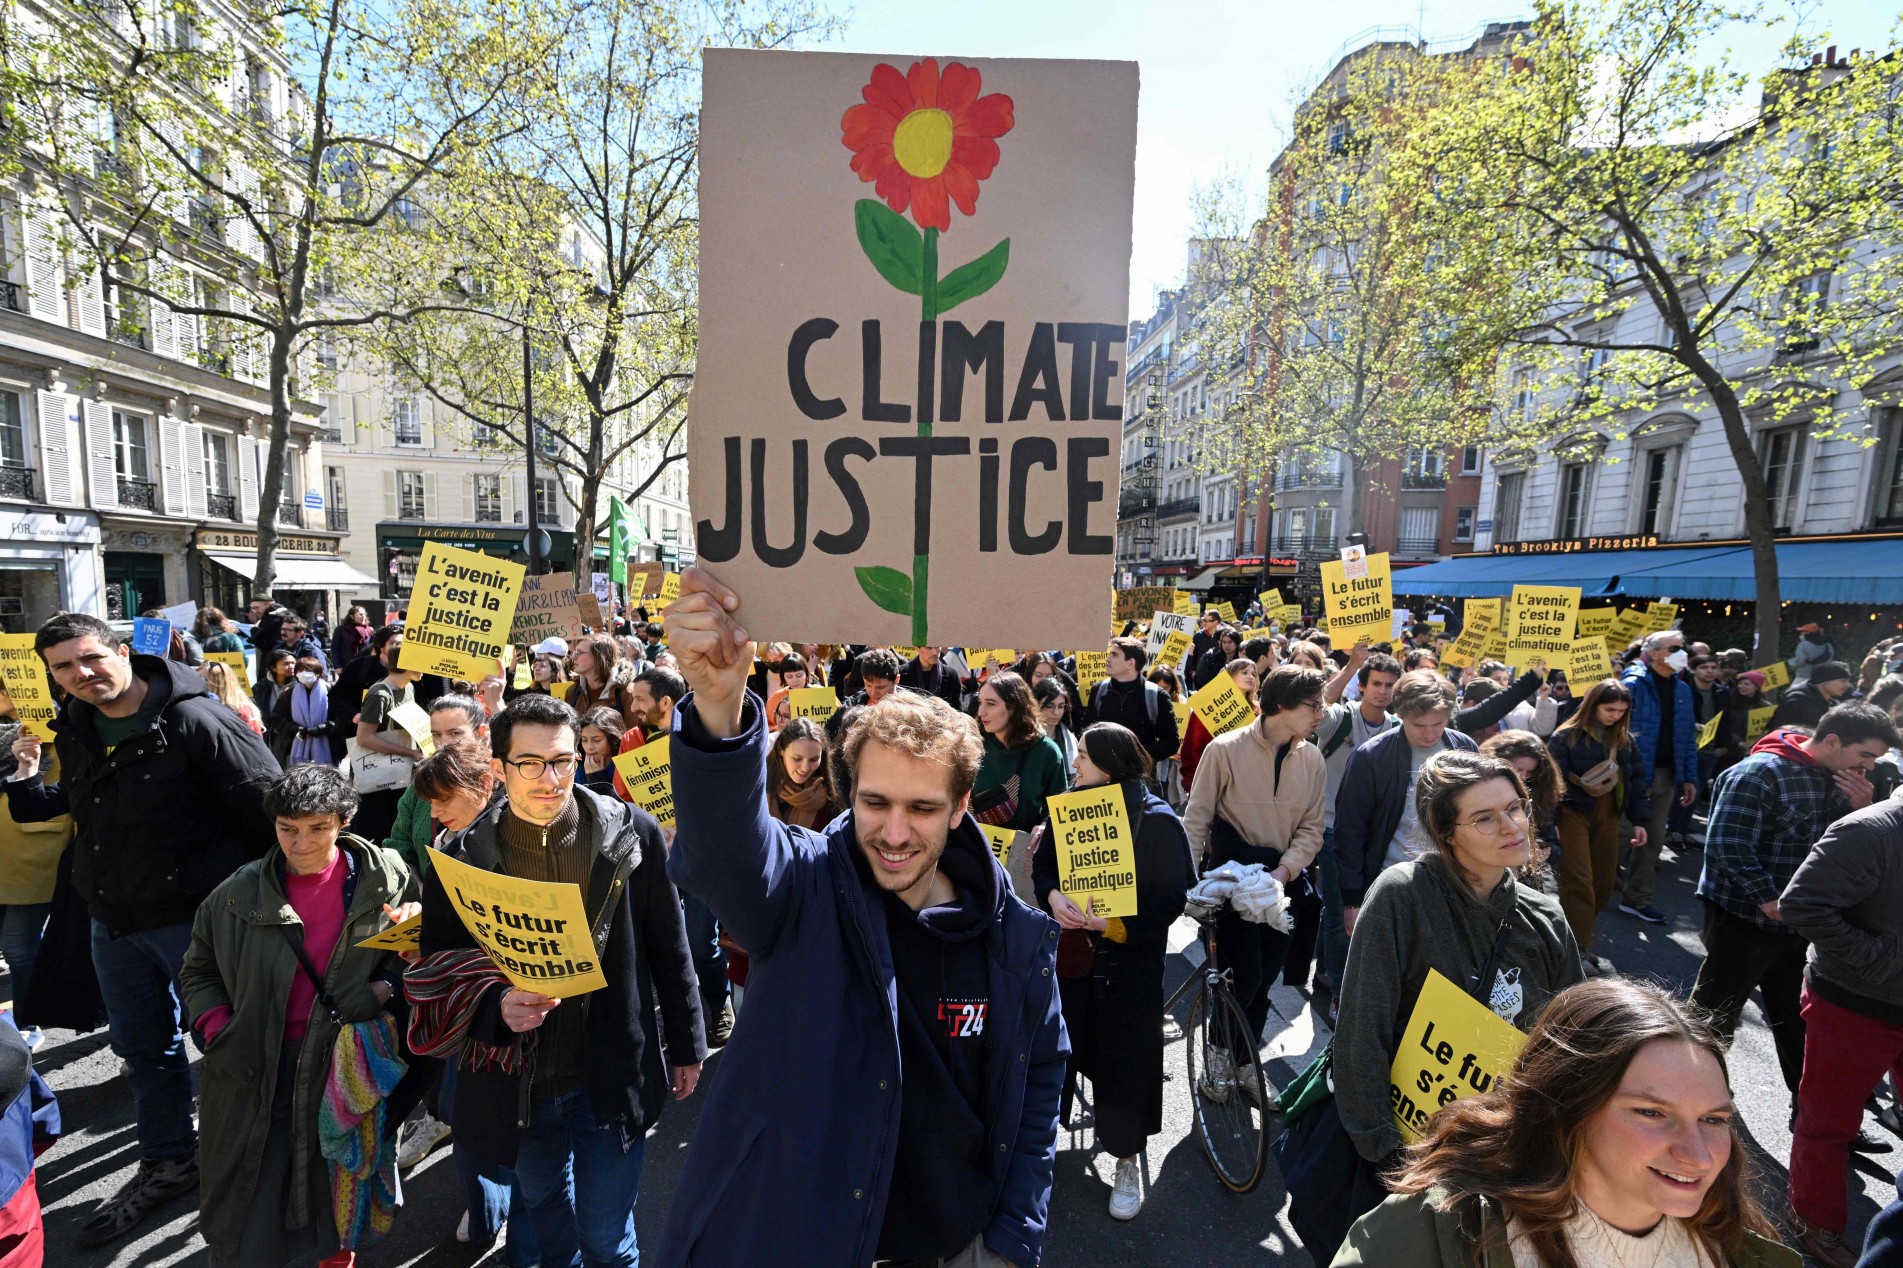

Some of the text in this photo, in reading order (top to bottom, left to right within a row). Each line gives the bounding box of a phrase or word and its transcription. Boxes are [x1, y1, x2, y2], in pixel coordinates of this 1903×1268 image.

[788, 317, 1127, 423] CLIMATE
[697, 436, 1113, 568] JUSTICE
[418, 528, 496, 540] La Carte des Vins
[216, 535, 327, 552] 28 BOUGERIE 28
[1495, 536, 1658, 554] The Brooklyn Pizzeria
[428, 555, 511, 593] L'avenir,
[520, 577, 545, 594] ONNE
[1119, 588, 1171, 600] SAUVONS
[1331, 577, 1383, 595] Le futur
[429, 582, 500, 612] c'est la
[1117, 597, 1129, 608] LA
[1339, 592, 1380, 610] s'écrit
[1517, 593, 1571, 608] L'avenir,
[1118, 611, 1135, 620] LES
[1137, 604, 1154, 612] PAS
[1519, 608, 1550, 621] c'est
[1553, 610, 1565, 621] la
[422, 602, 492, 633] justice
[1160, 613, 1187, 631] VOTRE
[1330, 607, 1391, 627] ensemble
[143, 624, 163, 634] PARIS
[1517, 623, 1561, 637] justice
[406, 626, 501, 658] climatique
[1508, 638, 1570, 653] climatique
[1571, 642, 1602, 654] avenir,
[0, 644, 37, 661] avenir,
[1081, 651, 1109, 661] L'égalit
[1592, 652, 1601, 661] la
[3, 664, 36, 680] 'est la
[439, 662, 459, 670] POUR
[441, 667, 466, 676] FUTUR
[1079, 662, 1092, 670] des
[1081, 669, 1087, 678] à
[1572, 662, 1602, 676] justice
[797, 704, 832, 717] Le futur
[1200, 688, 1235, 717] Le futur
[18, 704, 54, 722] atique
[1212, 699, 1240, 724] s'écrit
[1213, 705, 1251, 738] ensemble
[635, 756, 649, 768] Le
[626, 763, 671, 787] féminism
[648, 779, 667, 795] est
[1056, 799, 1119, 825] L'avenir,
[1065, 822, 1118, 846] c'est la
[1070, 846, 1119, 873] justice
[1062, 870, 1133, 892] climatique
[454, 886, 567, 934] Le futur
[474, 920, 563, 956] s'écrit
[470, 930, 595, 978] ensemble
[1420, 1021, 1454, 1066] Le
